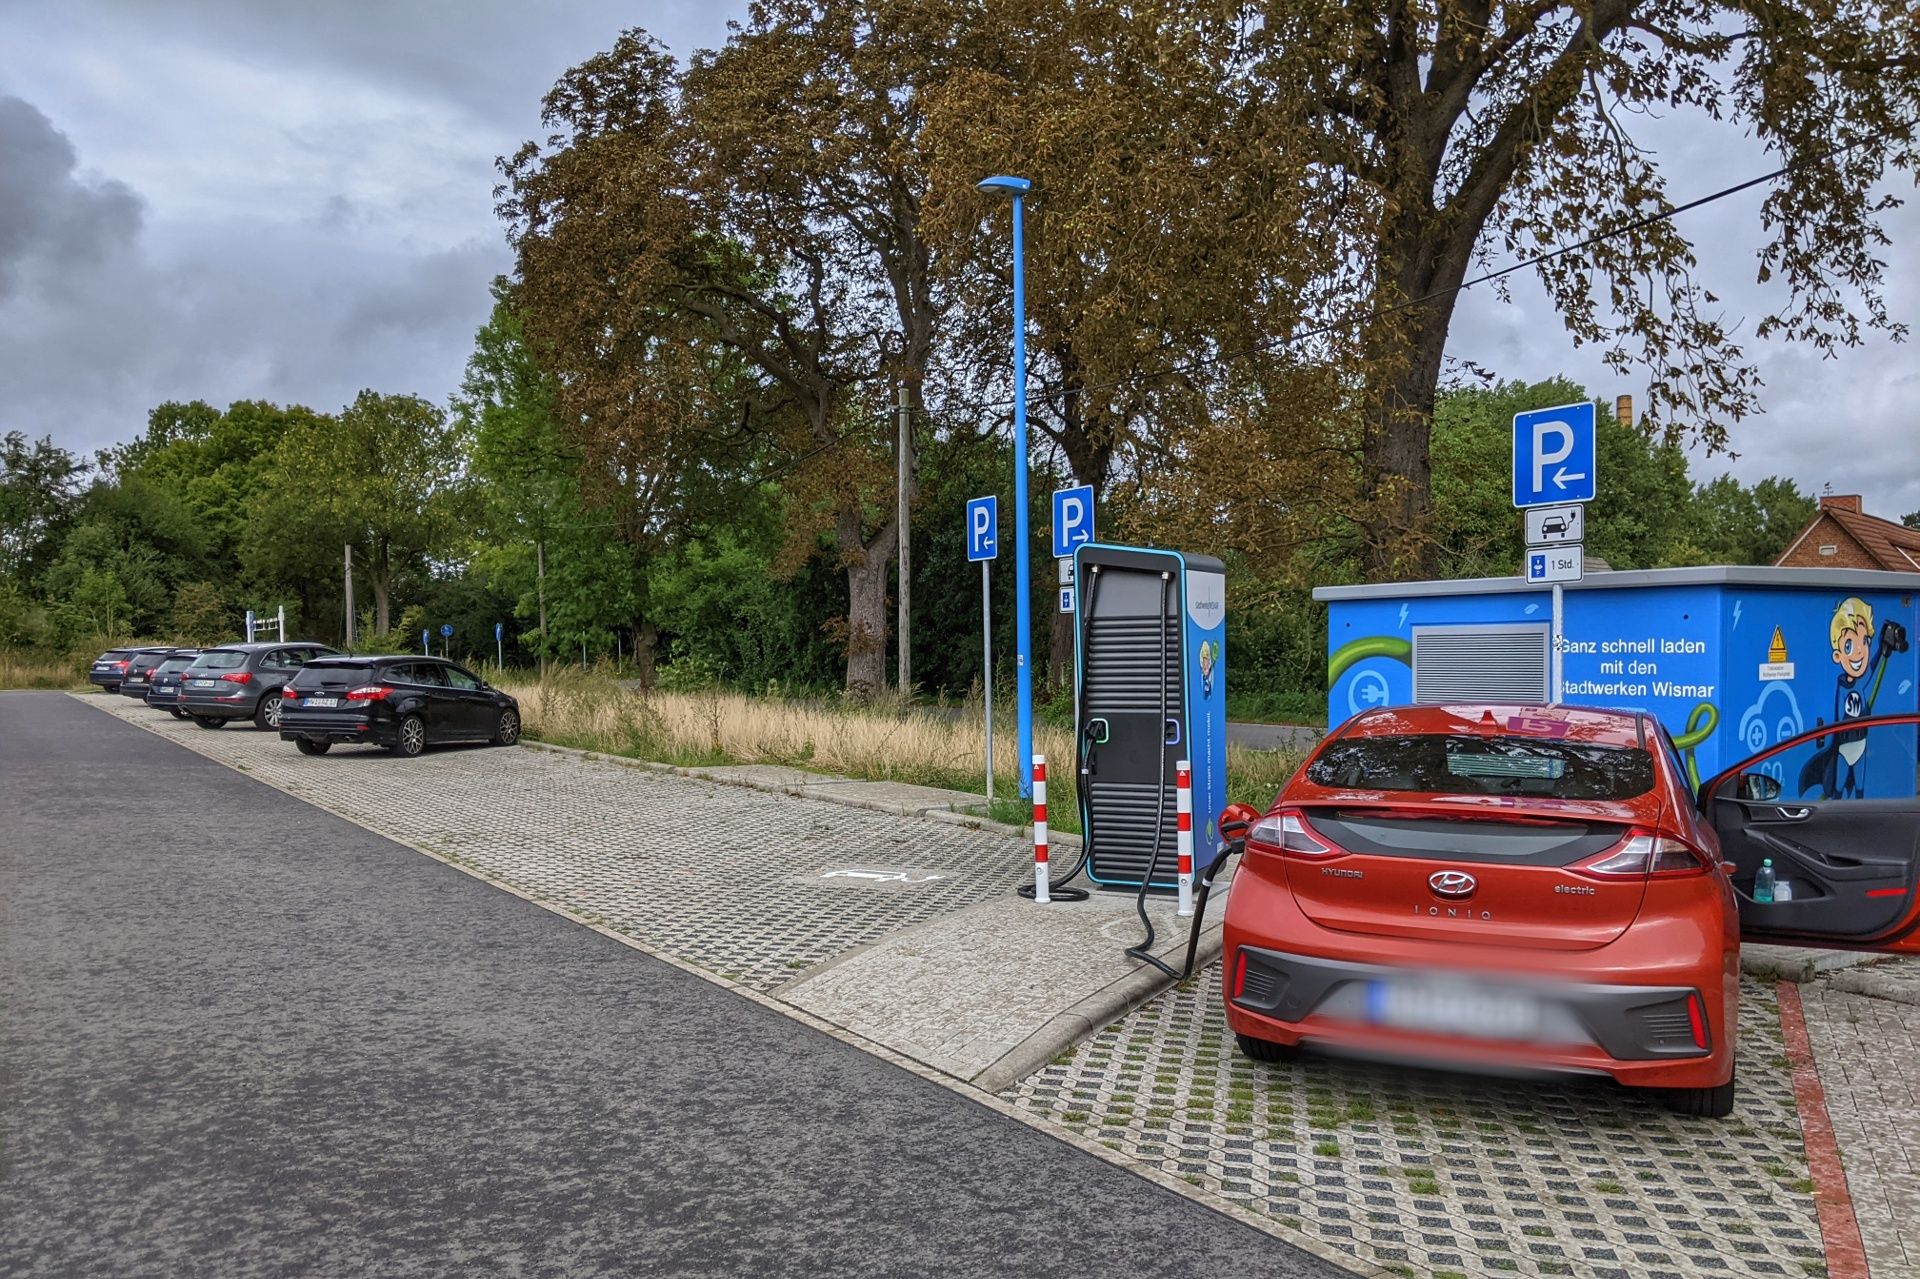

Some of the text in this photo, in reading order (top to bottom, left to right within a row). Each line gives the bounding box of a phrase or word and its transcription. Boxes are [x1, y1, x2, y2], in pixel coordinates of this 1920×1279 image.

[1532, 420, 1574, 493] P
[973, 506, 990, 552] P
[1062, 497, 1084, 548] P
[1551, 558, 1575, 570] 1 Std.
[1561, 638, 1706, 654] Ganz schnell laden
[1600, 660, 1657, 675] mit den
[1652, 681, 1715, 698] Wismar
[1321, 867, 1364, 879] HYUNDAI
[1553, 884, 1596, 896] electric
[1414, 904, 1491, 920] IONIQ
